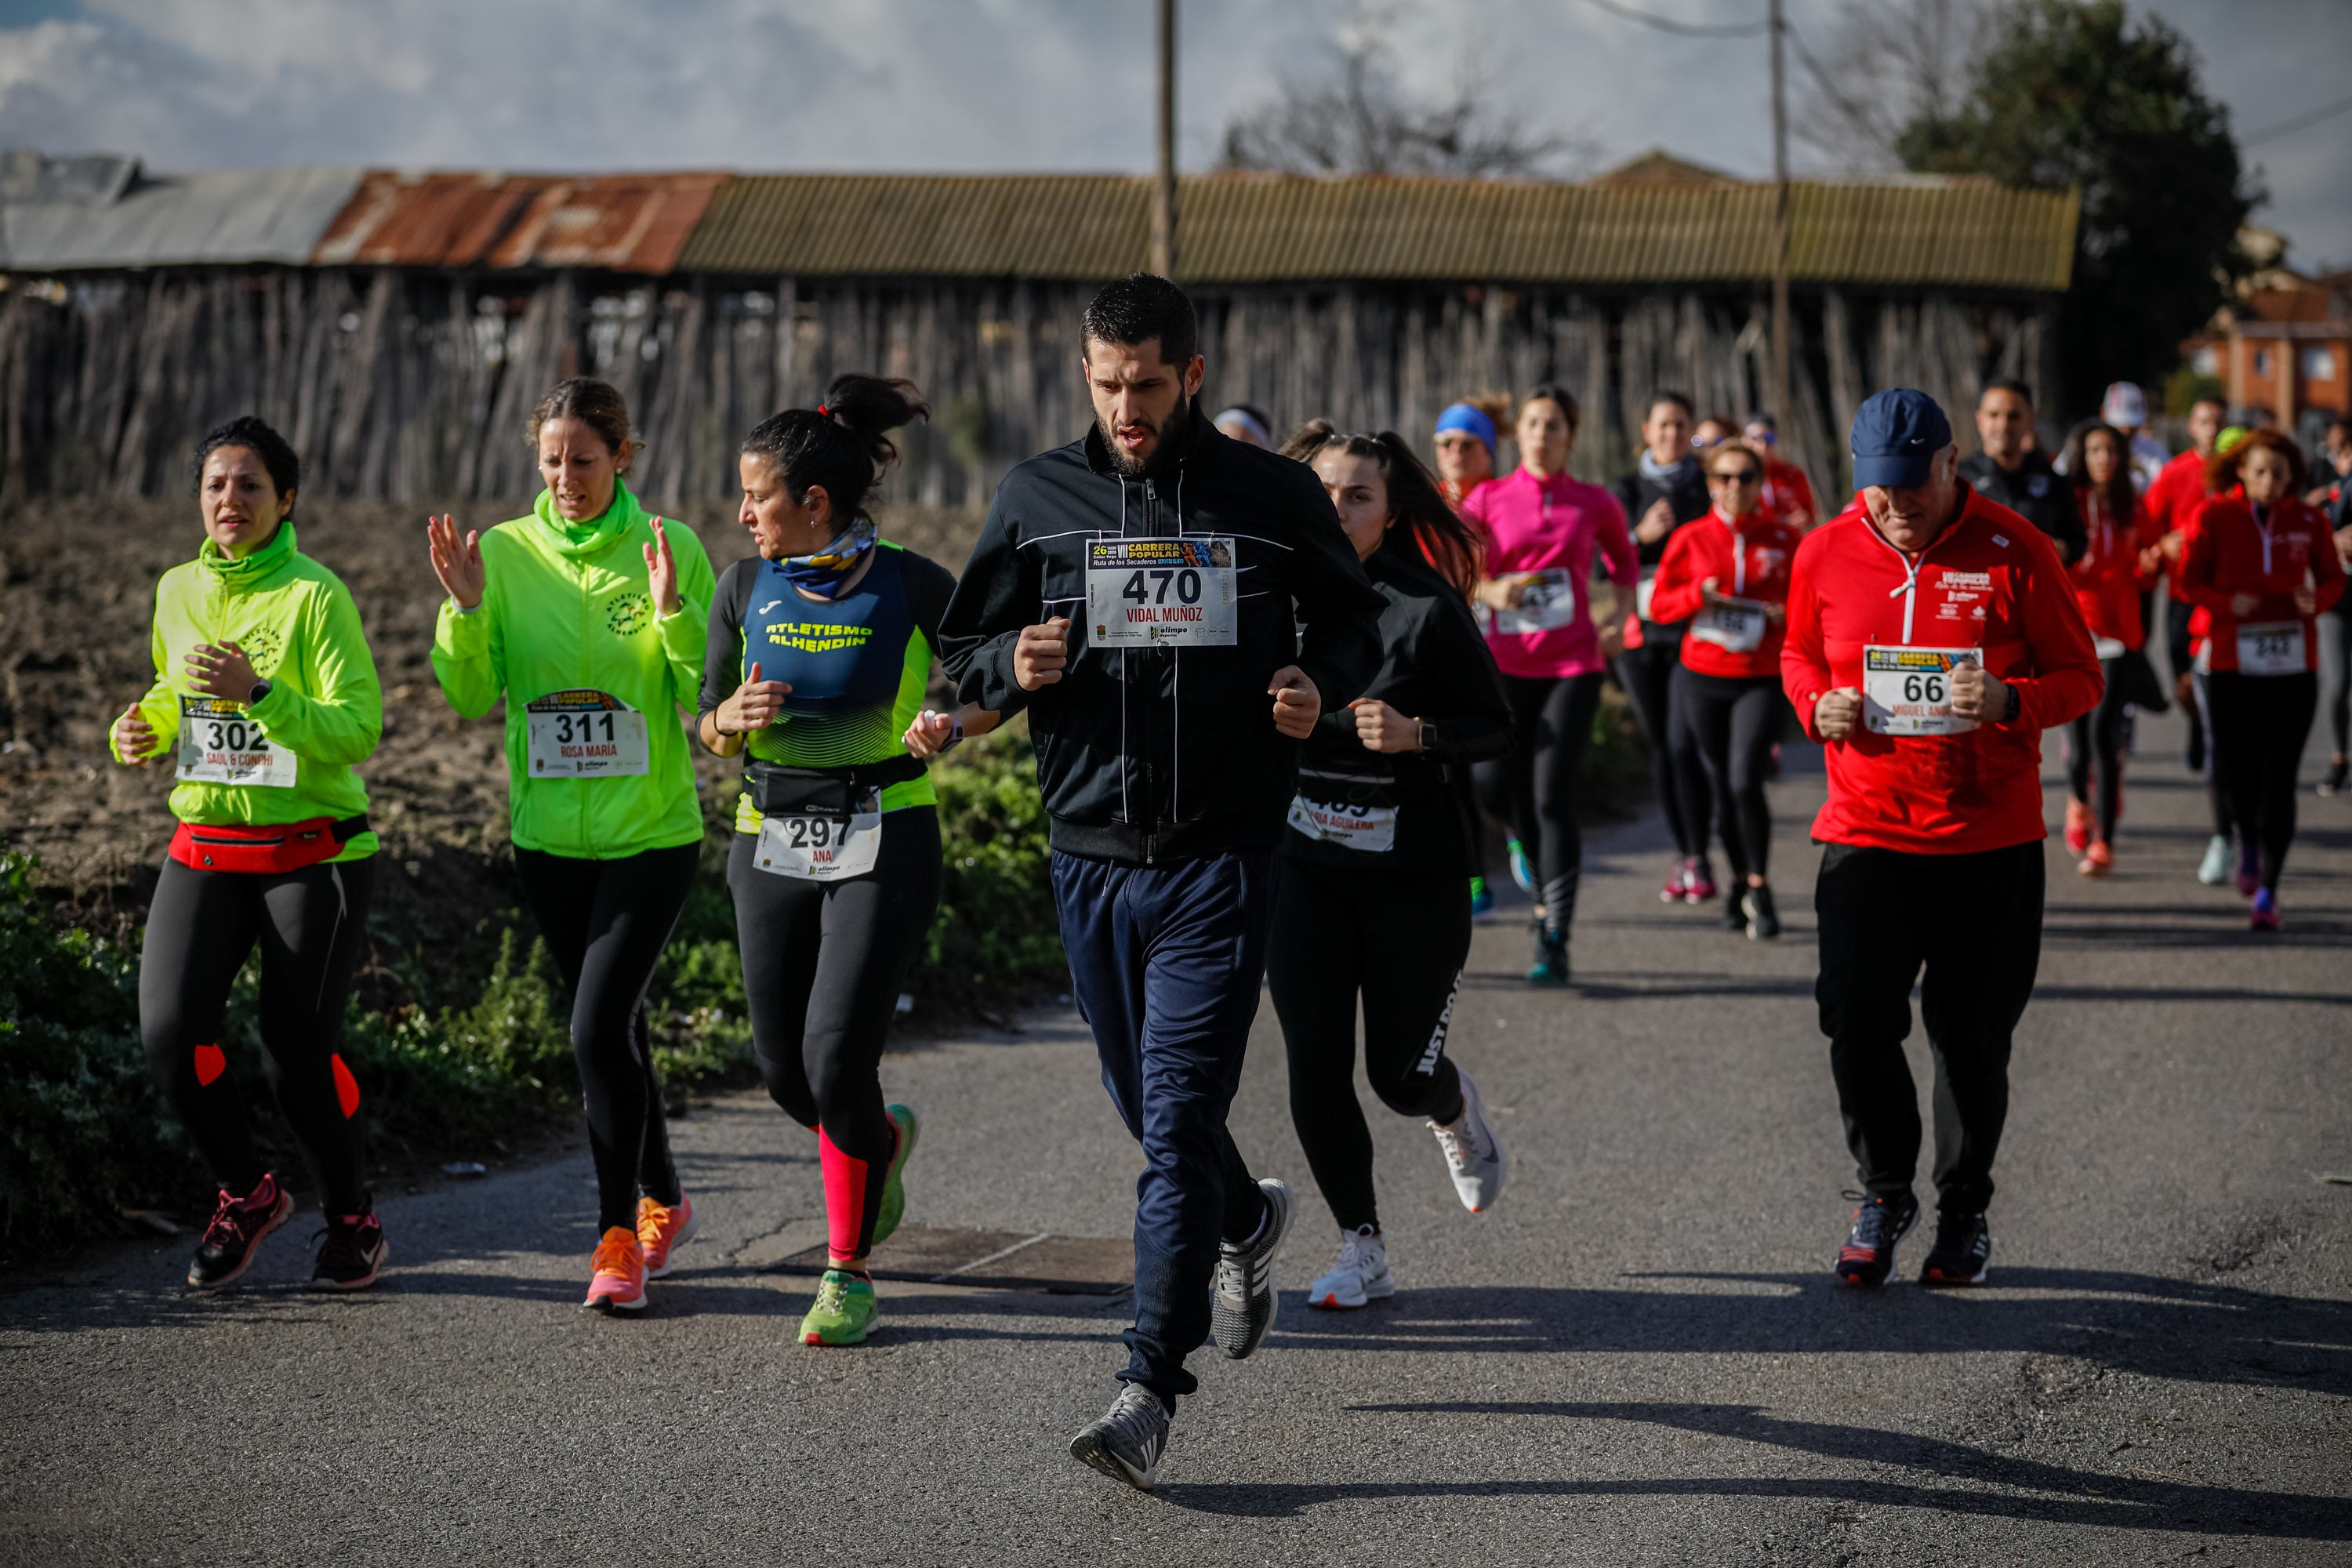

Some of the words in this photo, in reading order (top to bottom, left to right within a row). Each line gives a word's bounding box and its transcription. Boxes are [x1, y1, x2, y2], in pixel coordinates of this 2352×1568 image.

[1094, 545, 1107, 555] 26
[1117, 544, 1128, 558] VII
[1129, 543, 1180, 552] CARRERA
[1123, 569, 1202, 605] 470
[1127, 607, 1159, 622] VIDAL
[1163, 604, 1203, 622] MUÑOZ
[765, 622, 873, 637] ATLETISMO
[769, 634, 866, 653] ALHENDÍN
[1904, 675, 1944, 702] 66
[1892, 704, 1925, 716] MIGUEL
[556, 712, 614, 743] 311
[208, 722, 269, 750] 302
[561, 746, 583, 757] ROSA
[586, 742, 618, 757] MARÍA
[230, 753, 237, 765] &
[238, 753, 273, 766] CONCHI
[1329, 815, 1374, 830] AGUILERA
[789, 816, 852, 848] 297
[813, 849, 832, 862] ANA
[1416, 1024, 1446, 1076] JUST
[1142, 1393, 1158, 1410] adidas
